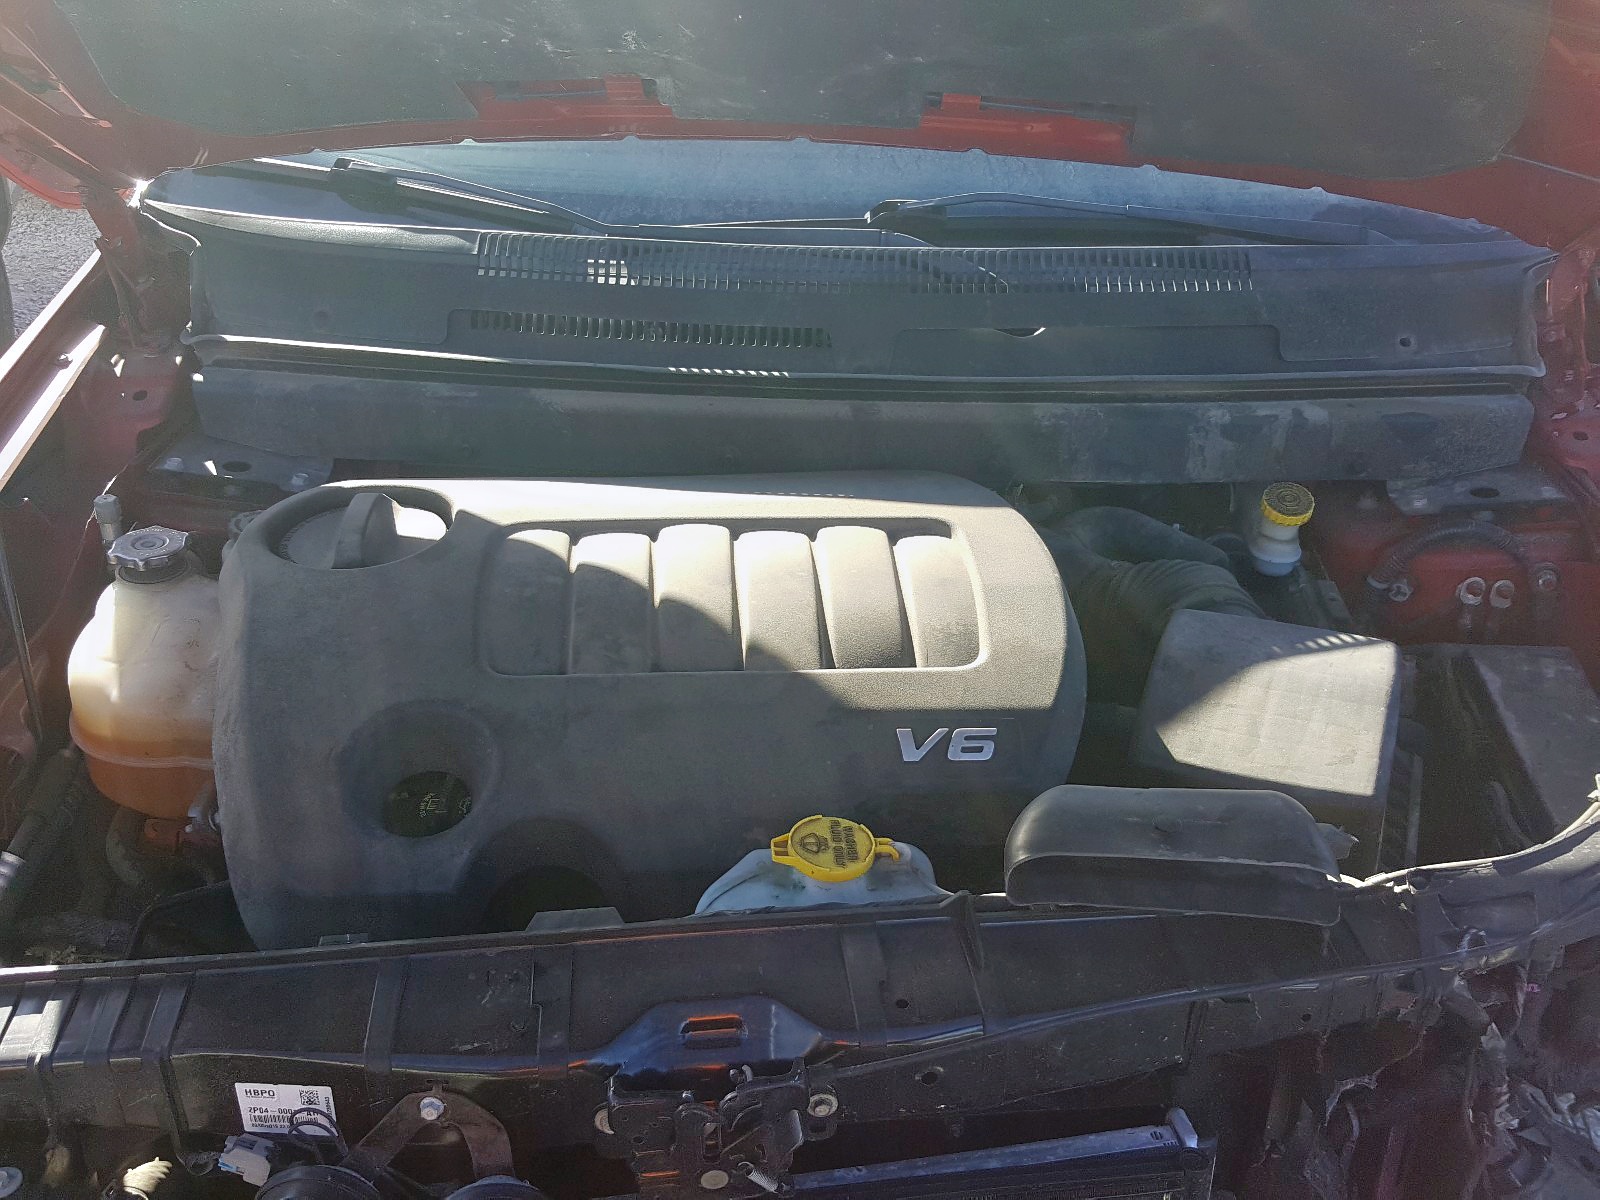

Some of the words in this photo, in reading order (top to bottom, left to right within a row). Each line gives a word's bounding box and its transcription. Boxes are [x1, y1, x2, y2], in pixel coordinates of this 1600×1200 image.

[896, 727, 998, 762] V6
[829, 819, 843, 844] FLUID
[843, 825, 860, 862] WASHER
[833, 844, 847, 869] ONLY
[244, 1088, 275, 1096] HBPO
